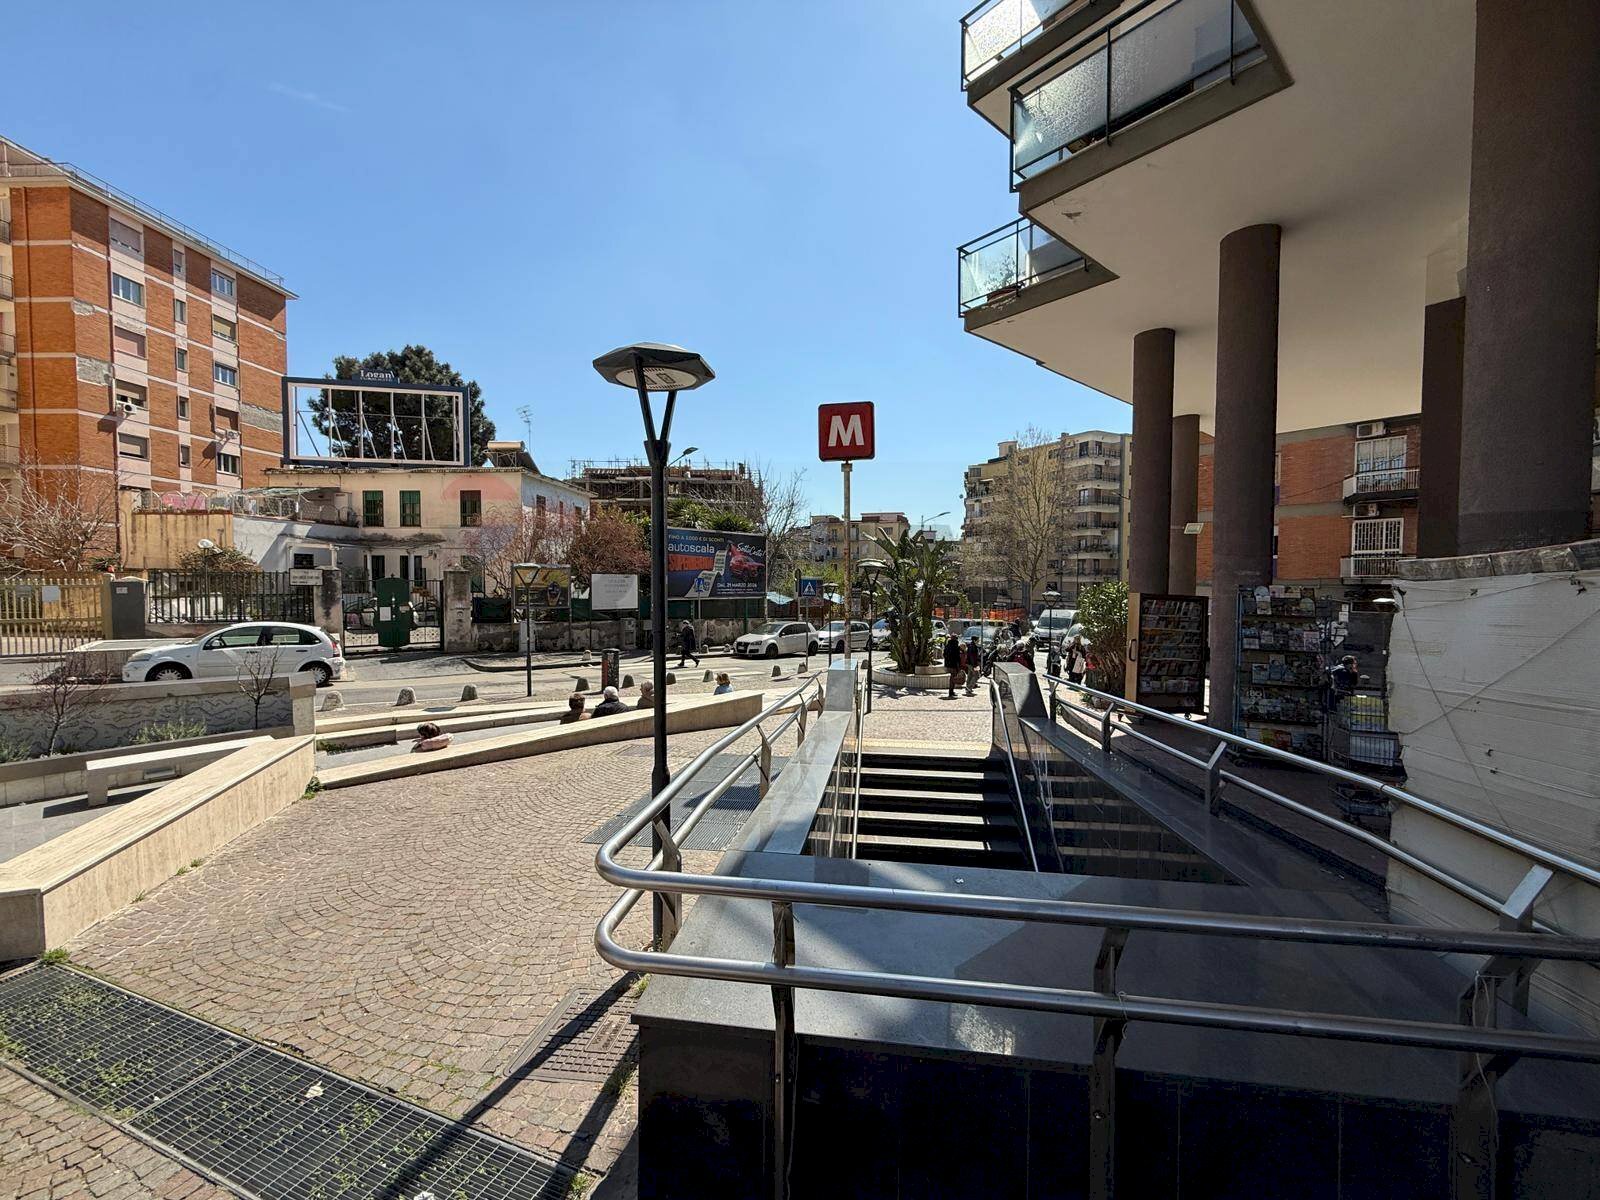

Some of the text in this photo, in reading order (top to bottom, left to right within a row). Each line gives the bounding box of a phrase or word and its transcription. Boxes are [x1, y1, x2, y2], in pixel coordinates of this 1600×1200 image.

[360, 370, 391, 379] Logan
[828, 415, 864, 446] M
[667, 542, 715, 554] autoscala
